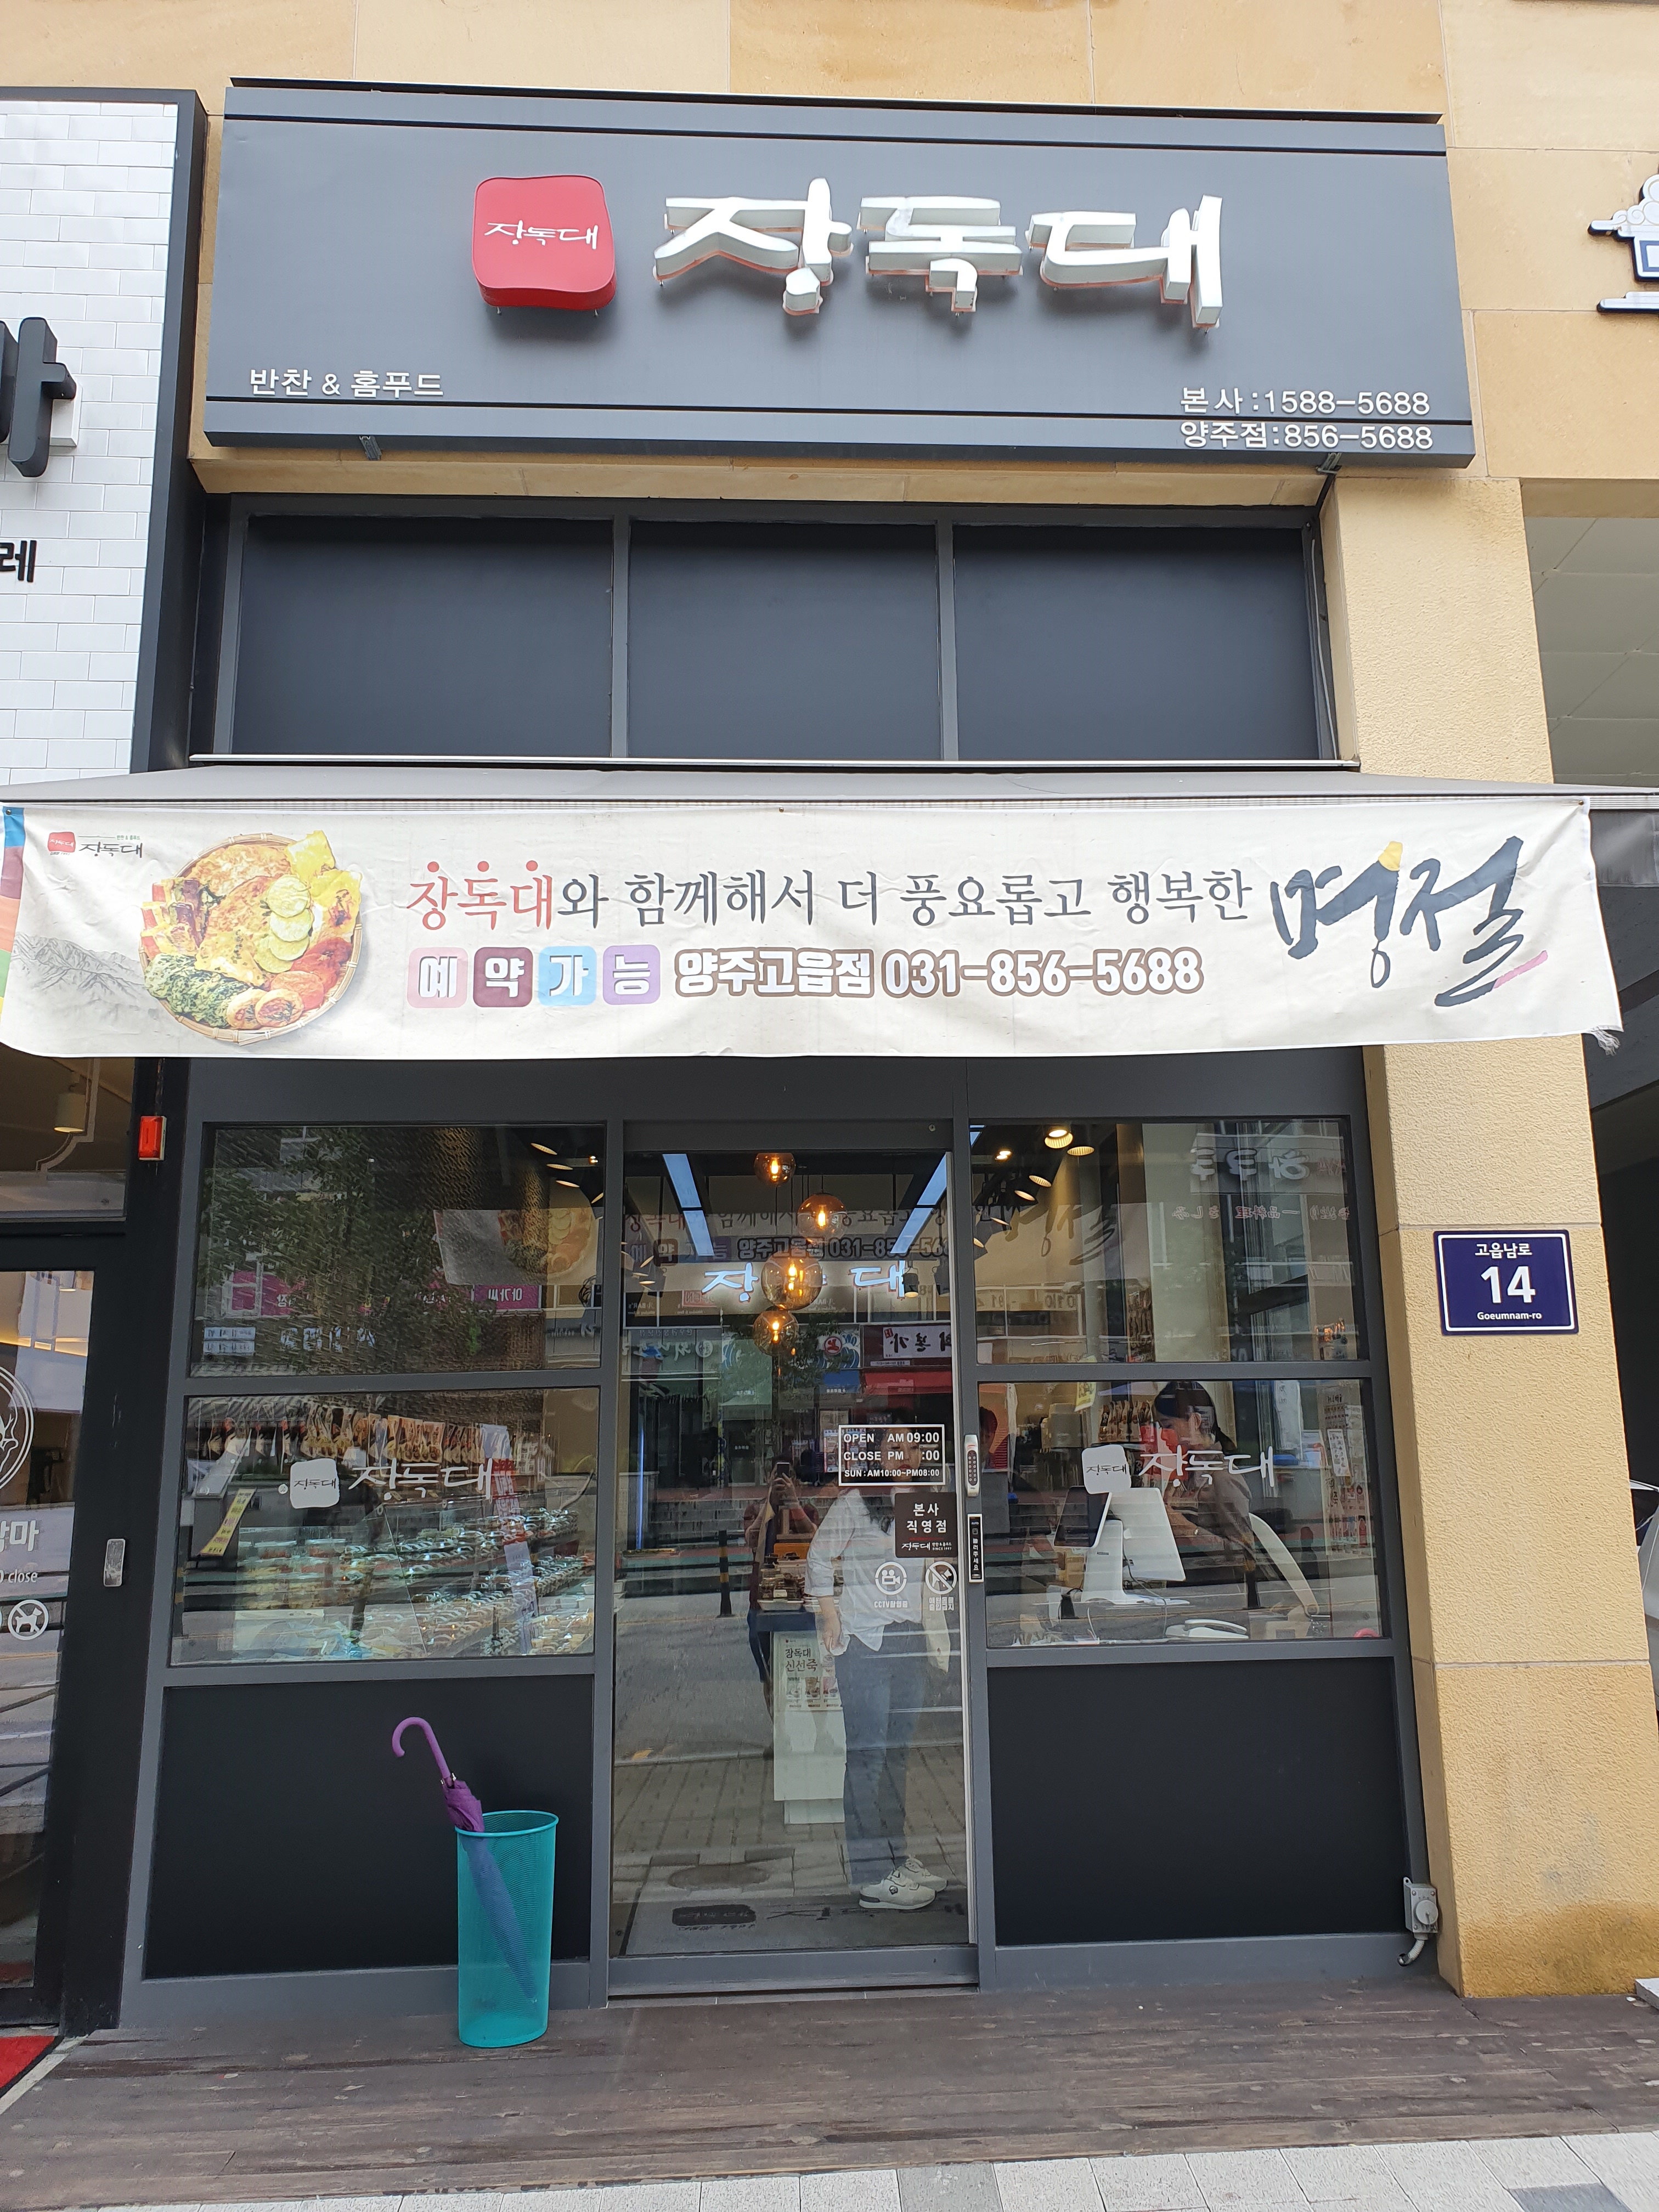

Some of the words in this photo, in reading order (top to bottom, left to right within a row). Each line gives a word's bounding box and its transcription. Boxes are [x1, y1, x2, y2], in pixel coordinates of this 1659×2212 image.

[484, 219, 598, 250] 장독대
[654, 178, 1223, 328] 장독대
[250, 369, 312, 396] 반찬
[321, 374, 341, 396] &
[351, 370, 443, 399] 홈푸드
[78, 841, 143, 858] 장독대
[407, 872, 609, 930] 장독대와
[624, 869, 814, 927] 함께해서
[837, 871, 877, 926] 더
[900, 873, 1091, 926] 풍요롭고
[1108, 869, 1252, 925] 행복한
[1270, 836, 1549, 1007] 명절
[416, 952, 653, 1000] 예약가능
[674, 946, 874, 997] 양주고읍점
[882, 946, 1204, 997] 031-856-5688
[1475, 1242, 1532, 1259] 고읍남로
[702, 1261, 905, 1304] 장대
[1481, 1266, 1536, 1304] 14
[1477, 1312, 1542, 1320] Goeumnam-ro
[843, 1433, 874, 1443] OPEN
[887, 1433, 904, 1442] AM
[906, 1432, 940, 1443] 09:00
[843, 1451, 882, 1461] CLOSE
[888, 1451, 904, 1460] PM
[1086, 1464, 1127, 1476] 장독대
[1138, 1444, 1274, 1488] 장독대
[294, 1478, 336, 1490] 장독대
[348, 1457, 493, 1500] 장독대
[913, 1503, 939, 1516] 본사
[906, 1519, 946, 1533] 직영점
[901, 1542, 930, 1550] 장독대
[8, 1569, 38, 1583] close
[785, 1647, 811, 1658] 장독대
[785, 1658, 818, 1672] 신선죽
